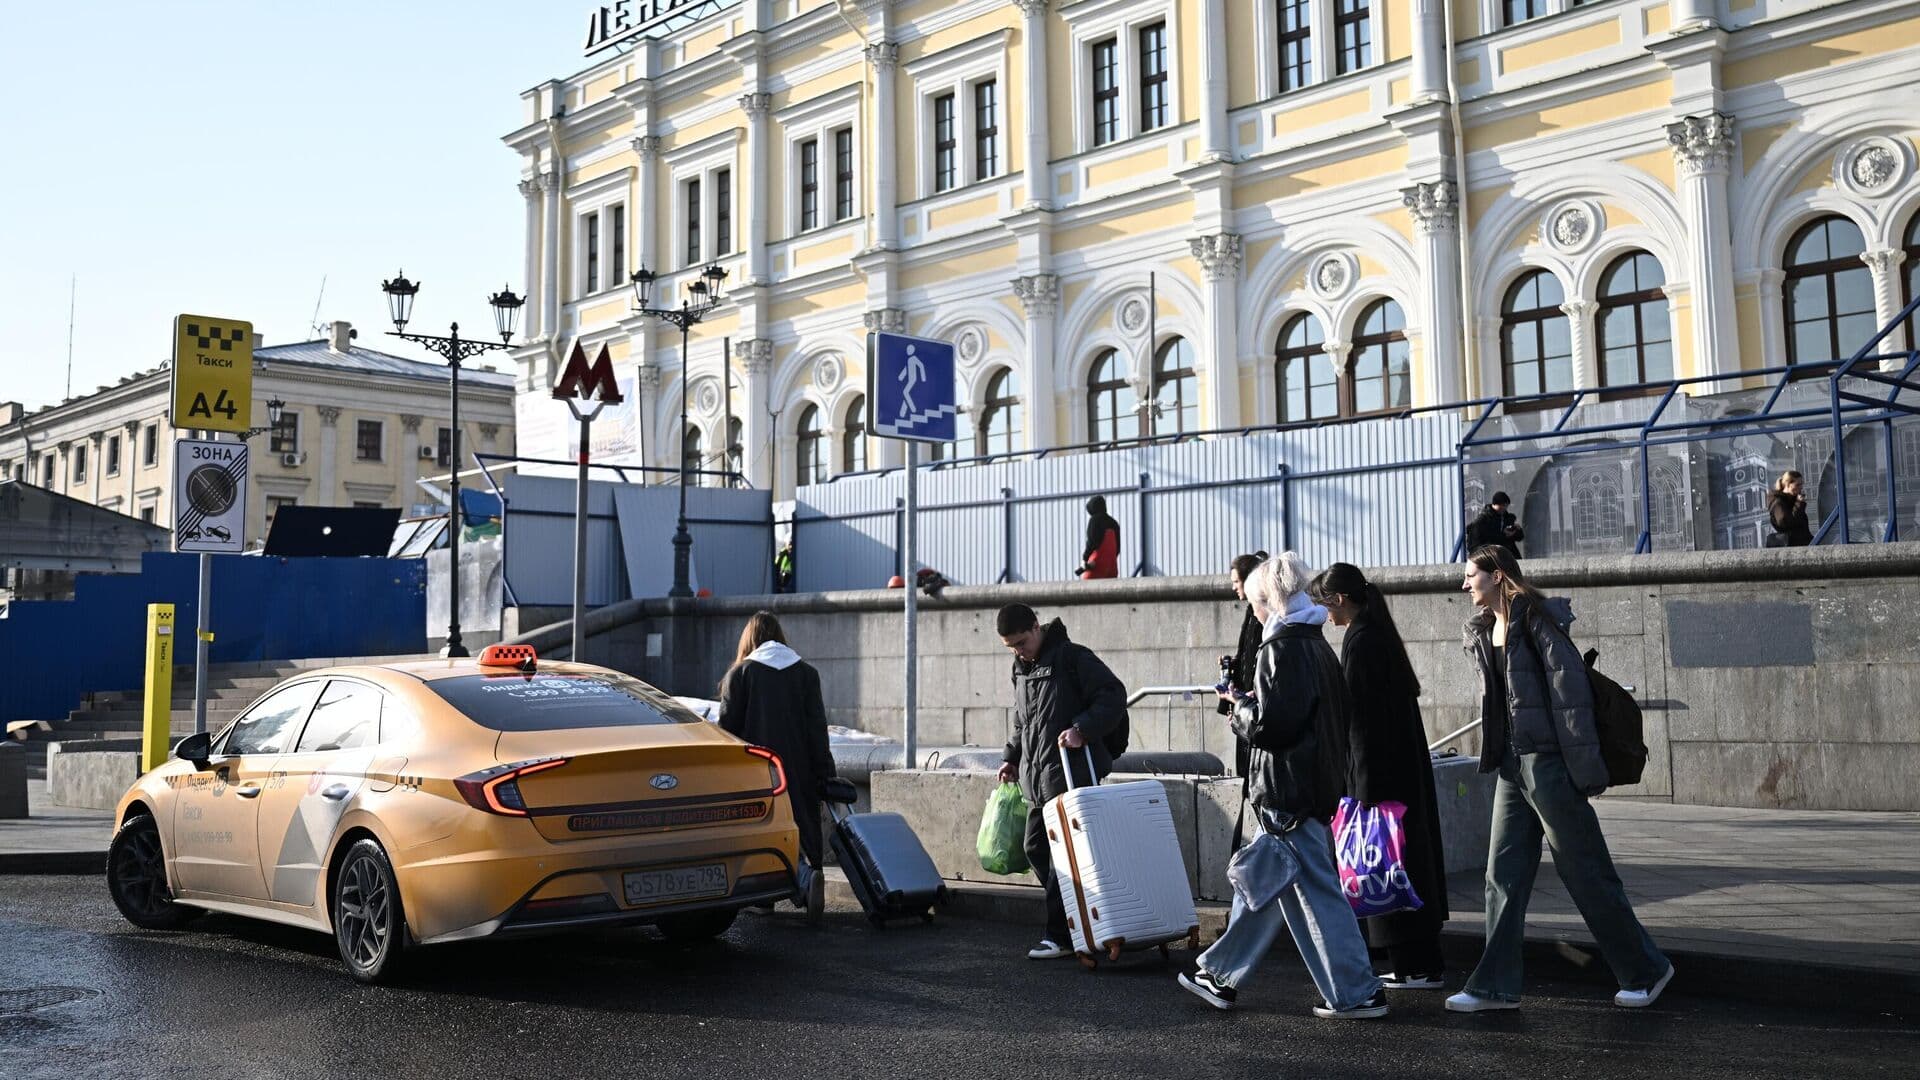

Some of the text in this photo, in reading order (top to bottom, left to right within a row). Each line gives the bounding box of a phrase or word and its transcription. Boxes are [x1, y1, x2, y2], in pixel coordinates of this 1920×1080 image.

[196, 353, 233, 368] Такси
[188, 389, 238, 420] А4
[192, 446, 233, 461] ЗОНА
[524, 689, 559, 697] 999
[699, 867, 722, 882] 799
